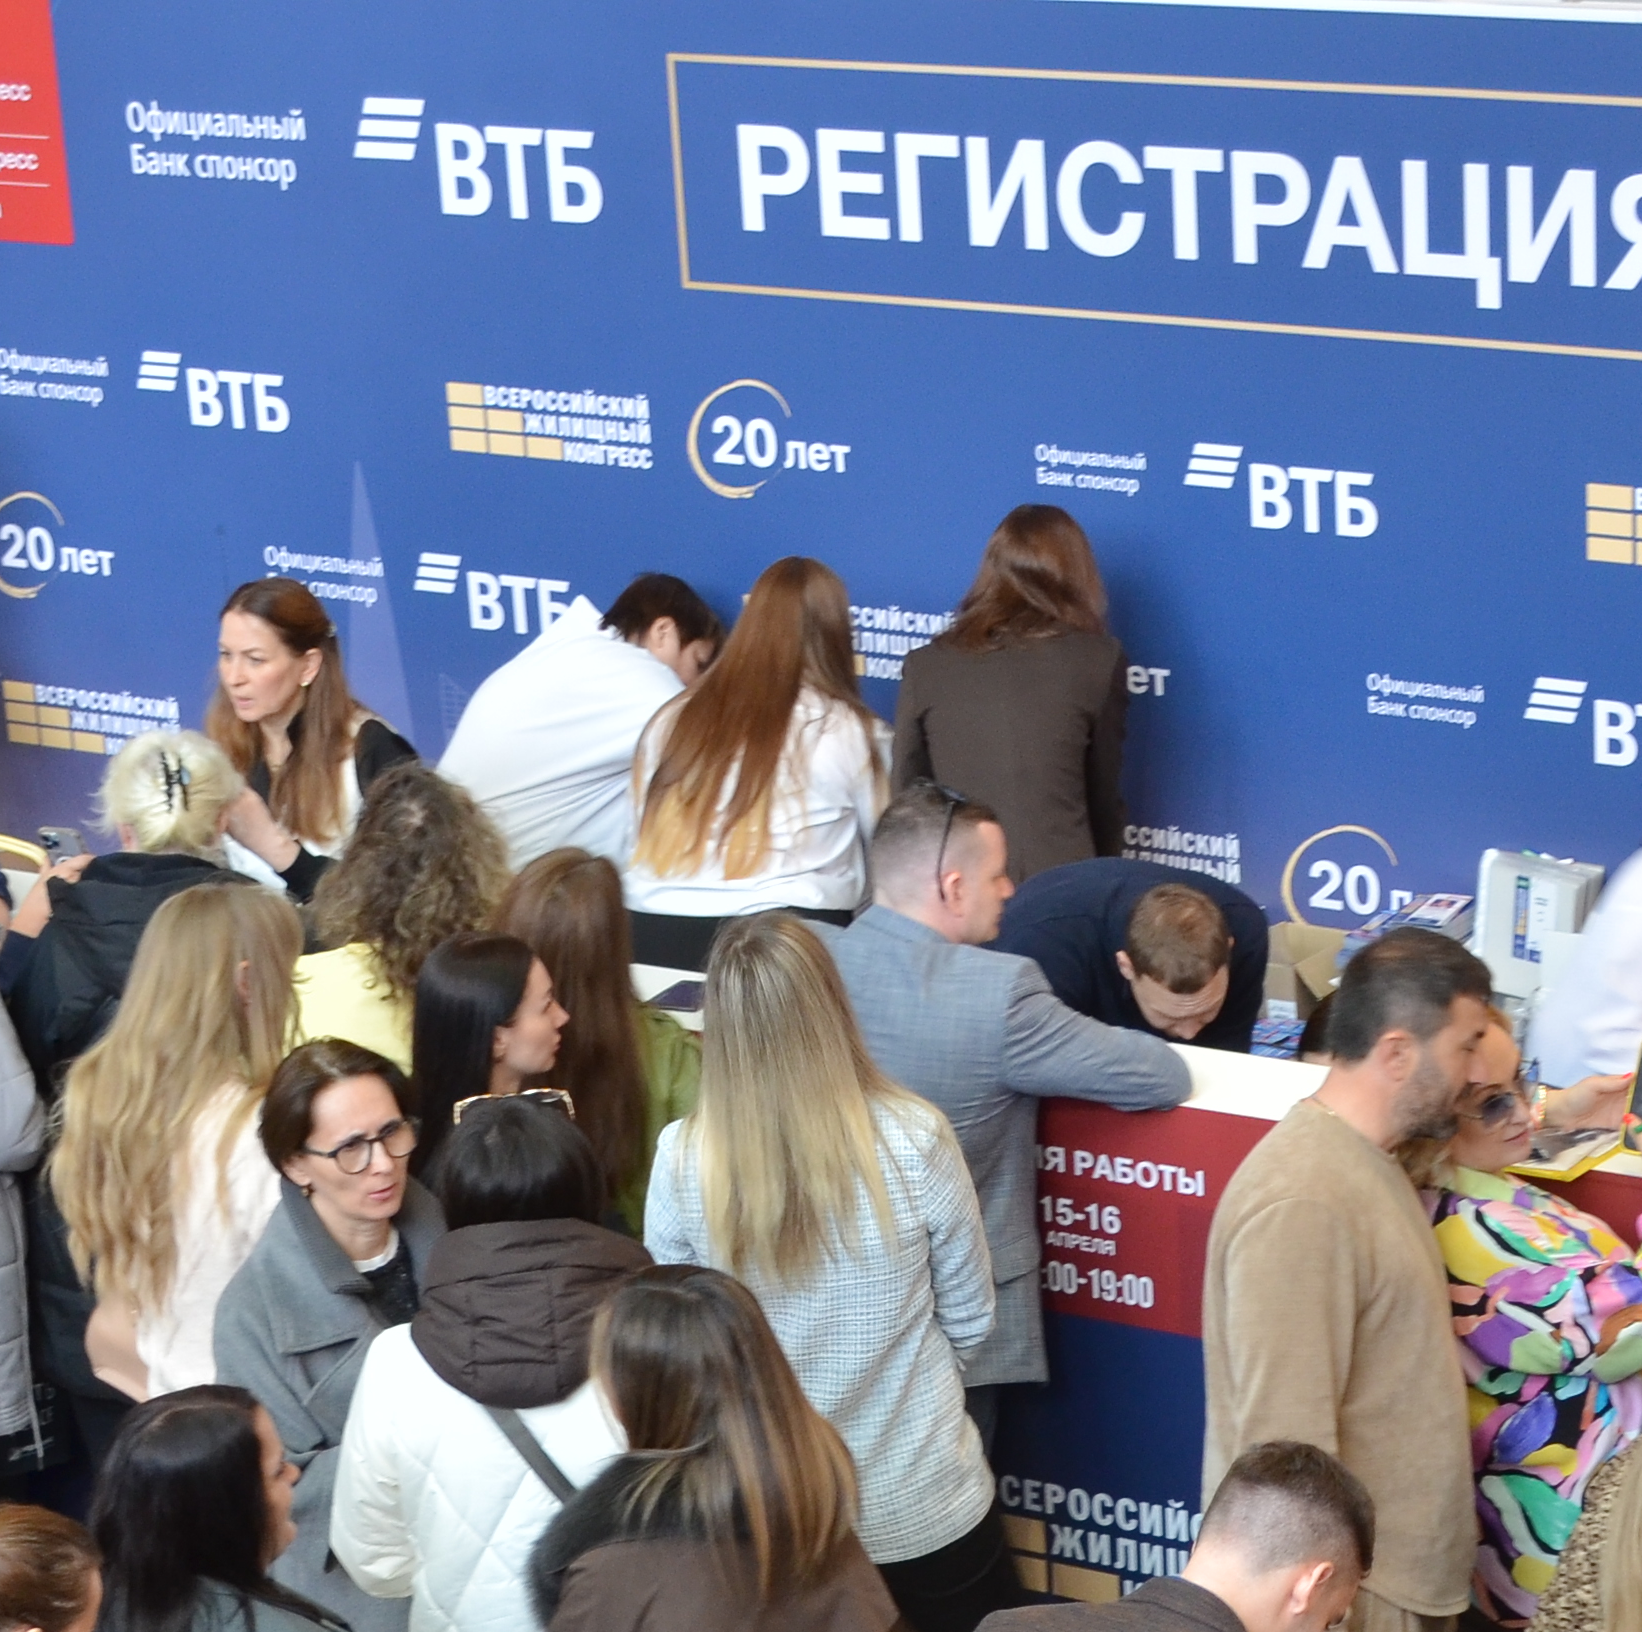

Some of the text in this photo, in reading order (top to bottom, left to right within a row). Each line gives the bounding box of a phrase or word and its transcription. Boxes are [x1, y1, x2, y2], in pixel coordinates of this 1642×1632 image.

[124, 99, 308, 142] Официальный
[129, 143, 298, 191] Банк спонсор
[434, 122, 604, 225] ВТБ
[38, 378, 105, 408] спонсор
[186, 367, 291, 434] ВТБ
[483, 385, 651, 420] ВСЕРОССИЙСКИЙ
[523, 411, 652, 445] ЖИЛИЩНЫЙ
[712, 415, 851, 474] 20 лет
[562, 440, 654, 471] КОНГРЕСС
[1034, 443, 1148, 471] Официальный
[1035, 466, 1140, 498] Банк спонсор
[1248, 462, 1380, 539] ВТБ
[59, 545, 115, 578] лет
[263, 545, 385, 578] Официальный
[308, 581, 378, 608] спонсор
[1126, 662, 1171, 697] ет
[1366, 672, 1486, 704] Официальный
[35, 684, 181, 721] ВСЕРОССИЙСКИЙ
[1366, 695, 1477, 729] Банк спонсор
[1308, 859, 1382, 916] 20
[1073, 1150, 1206, 1197] РАБОТЫ
[1040, 1196, 1122, 1235] 15-16
[1045, 1230, 1117, 1256] АПРЕЛЯ
[1041, 1260, 1155, 1309] :00-19:00
